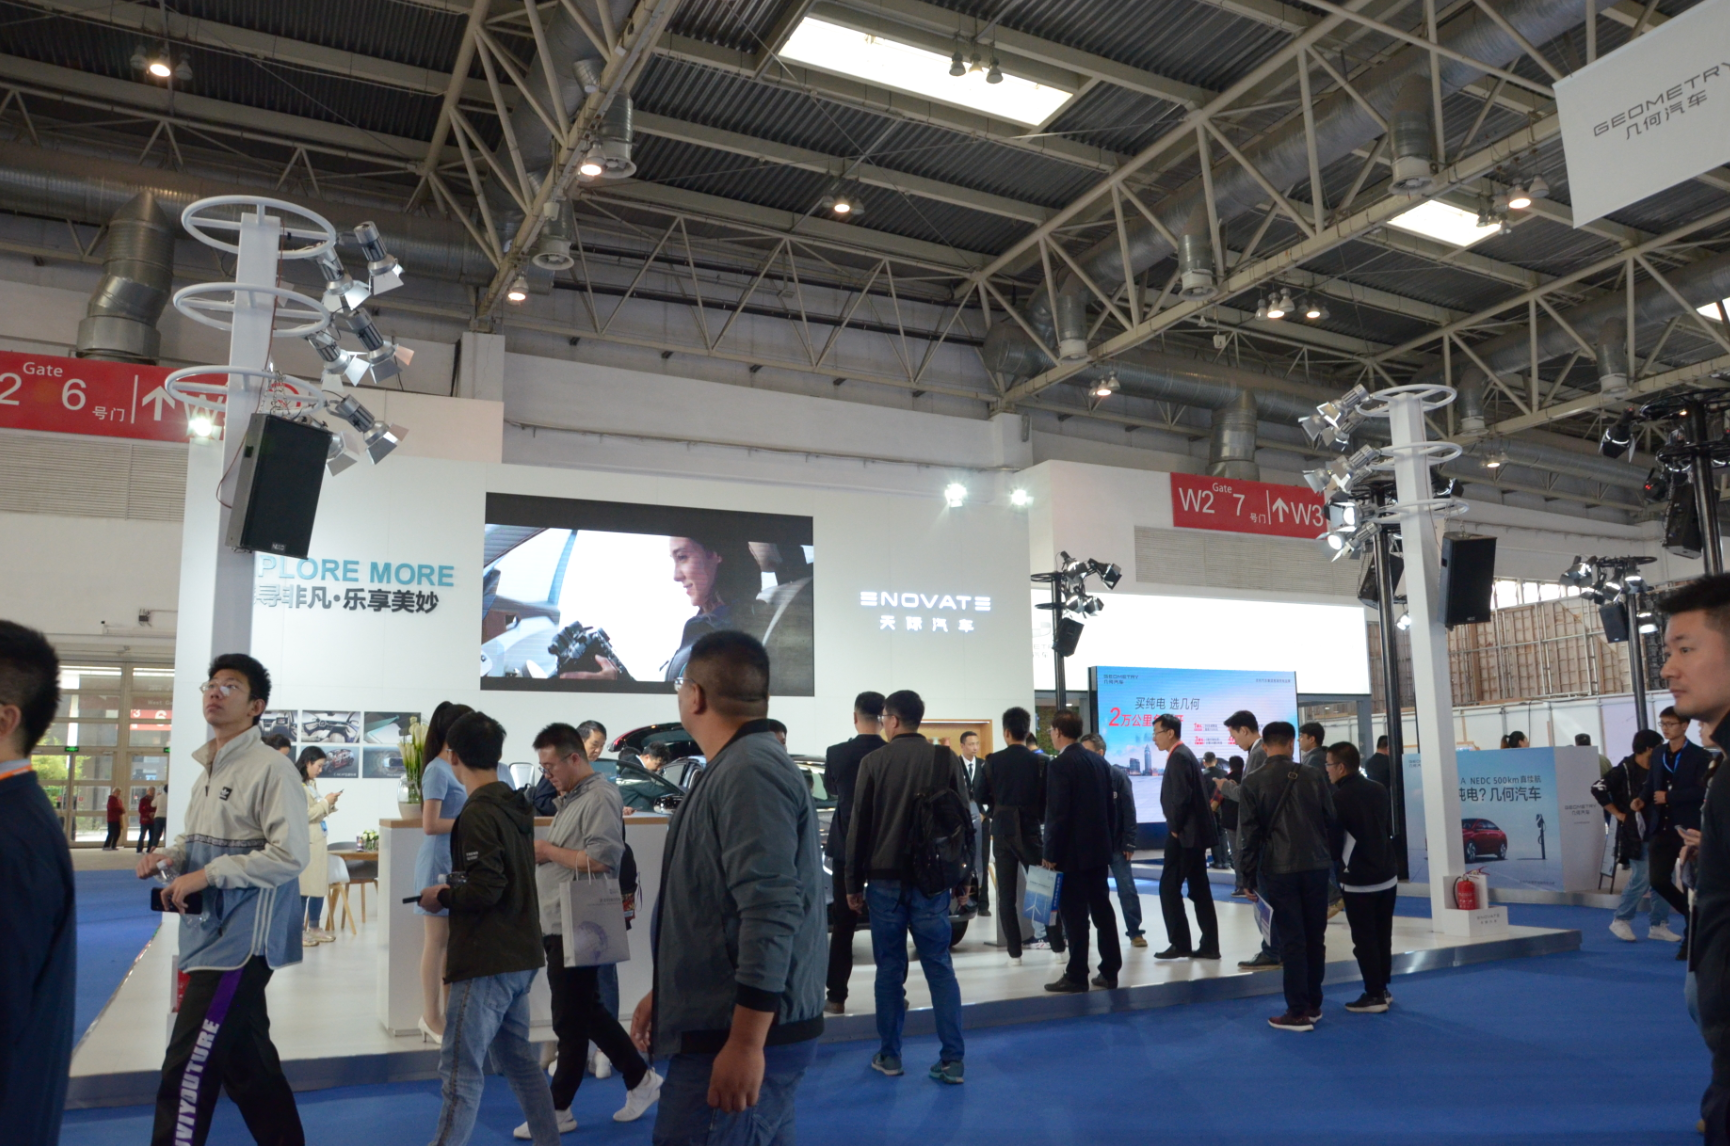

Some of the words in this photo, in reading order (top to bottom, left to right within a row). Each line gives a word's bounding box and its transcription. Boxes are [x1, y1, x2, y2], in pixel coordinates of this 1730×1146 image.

[1626, 89, 1708, 140] 几何汽车
[22, 361, 63, 377] Gate
[61, 378, 87, 411] 6
[92, 406, 125, 422] 号门
[1212, 482, 1233, 494] Gate
[1178, 487, 1215, 514] W2
[1232, 493, 1246, 516] 7
[1250, 513, 1266, 524] 号门
[1290, 501, 1324, 527] W3
[370, 561, 455, 587] MORE
[860, 591, 991, 612] ENOVATE
[1135, 697, 1166, 710] 买纯电
[1169, 697, 1201, 711] 选几何
[1470, 776, 1491, 785] NEDC
